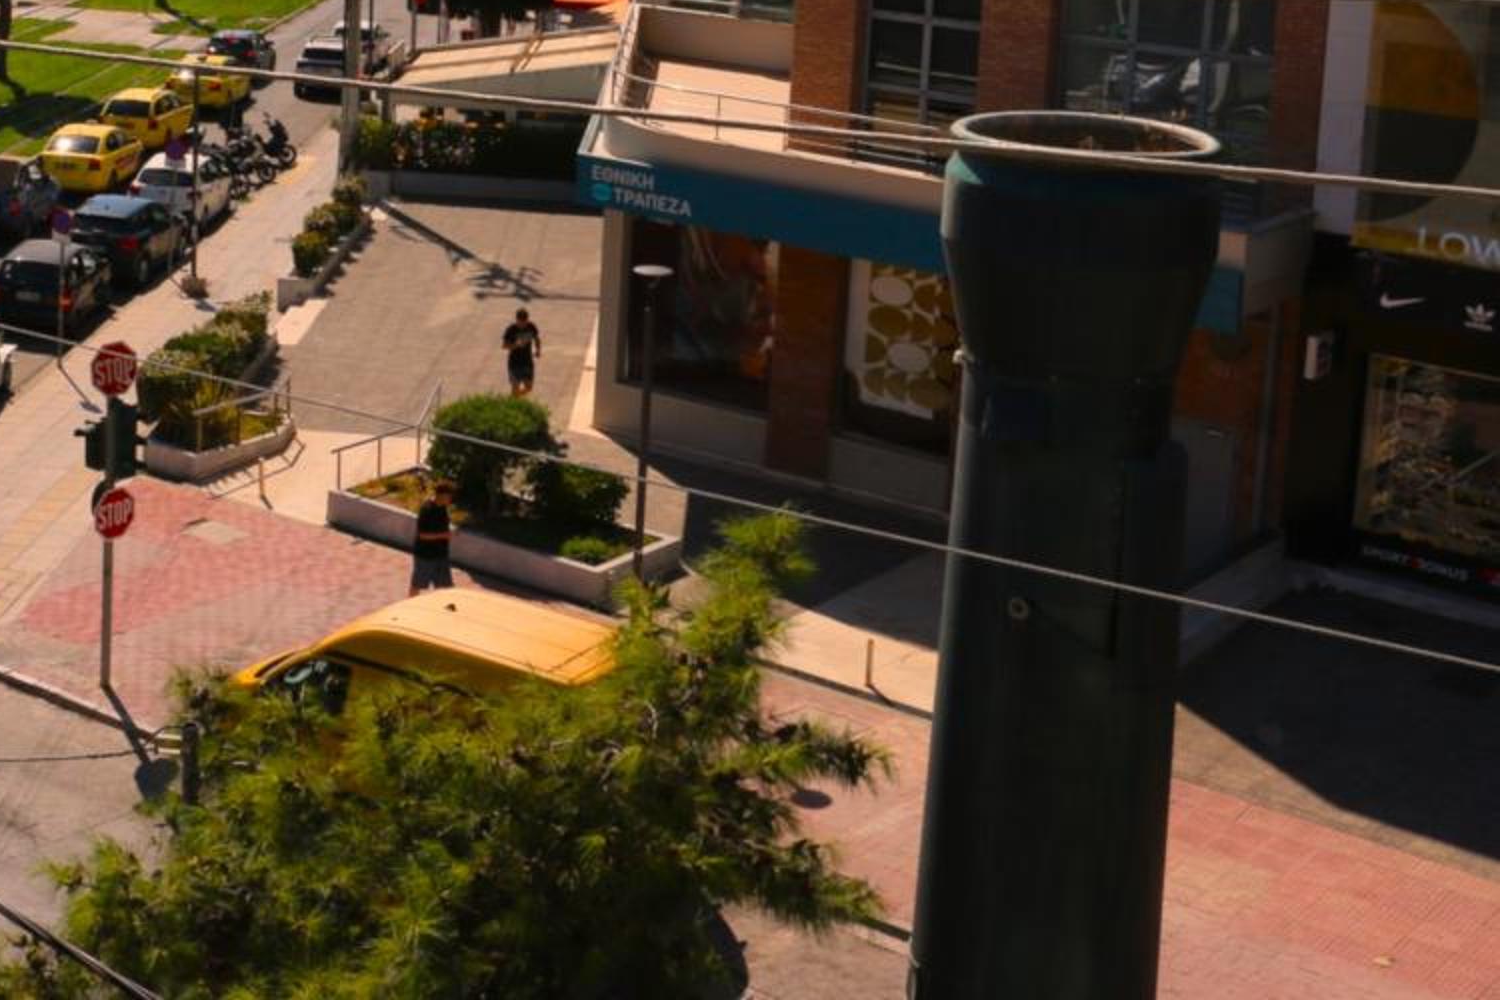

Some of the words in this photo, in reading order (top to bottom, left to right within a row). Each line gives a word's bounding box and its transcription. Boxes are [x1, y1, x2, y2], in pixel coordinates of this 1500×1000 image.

[591, 165, 655, 191] ΕΘΝΙΚΗ
[613, 189, 692, 218] ΤΡΑΠΕΖΑ
[93, 359, 134, 383] STOP
[94, 498, 133, 530] STOP
